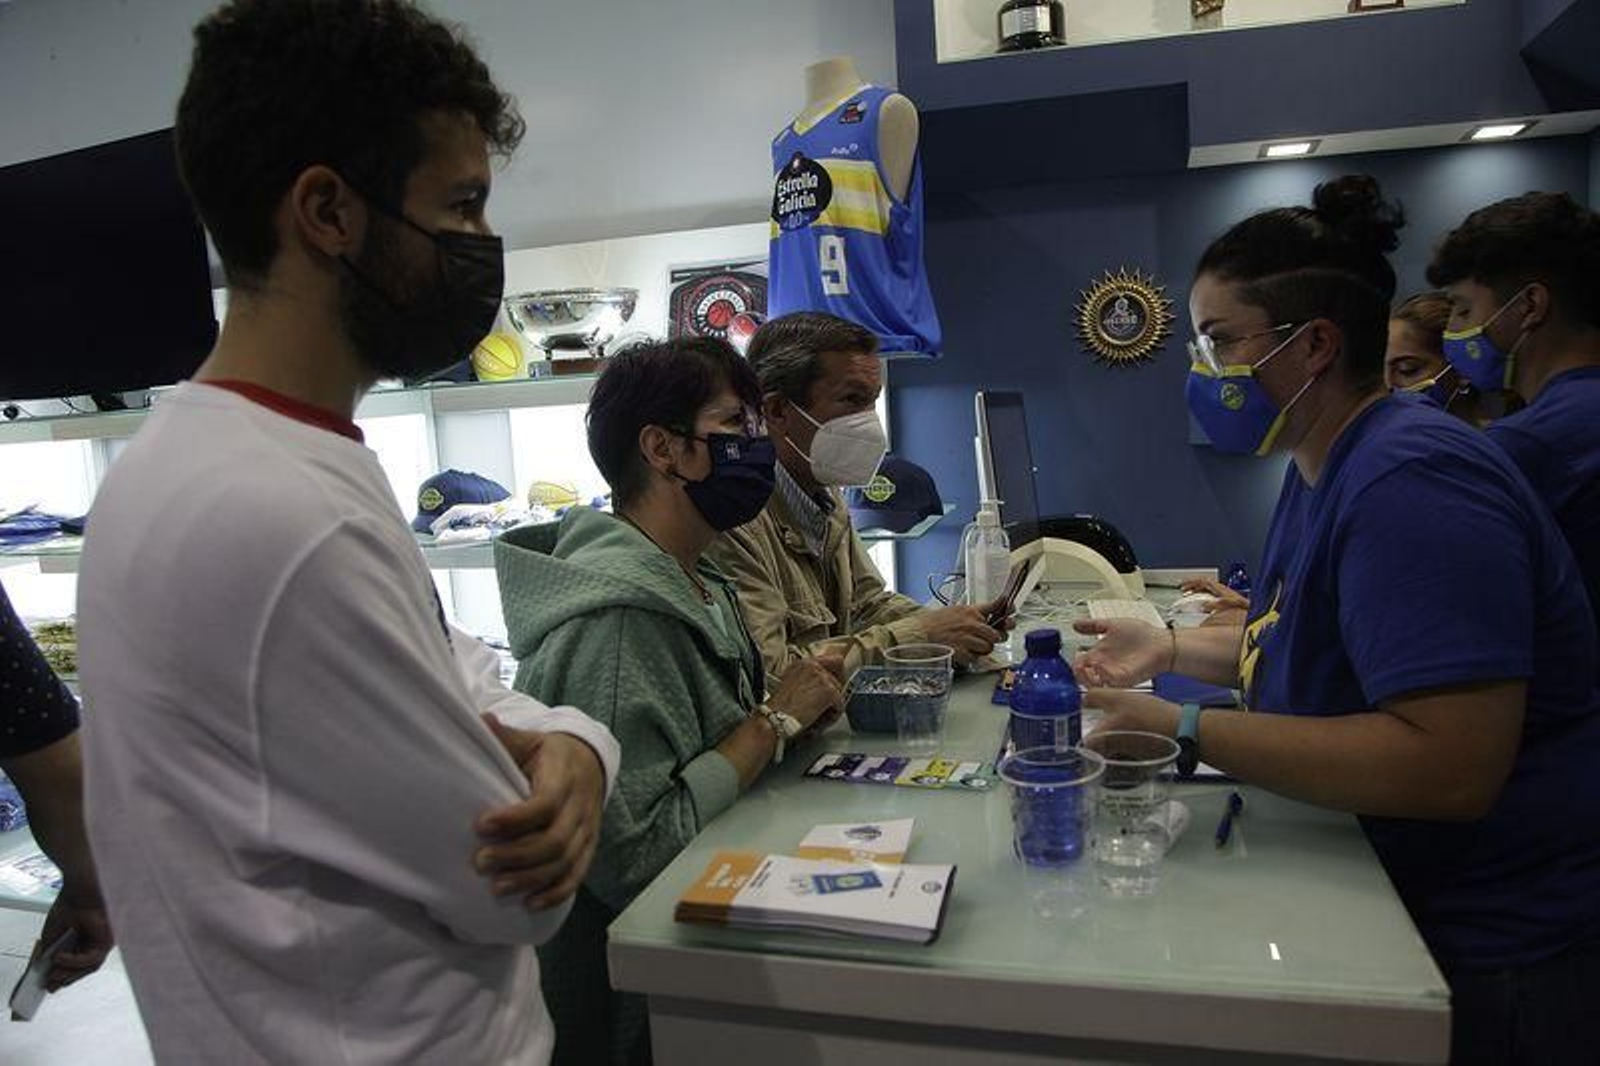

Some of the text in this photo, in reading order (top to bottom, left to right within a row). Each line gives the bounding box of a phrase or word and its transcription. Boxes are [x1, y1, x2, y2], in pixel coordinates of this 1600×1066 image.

[777, 172, 818, 197] Estrella
[779, 191, 816, 214] Galicia
[819, 235, 849, 295] 9
